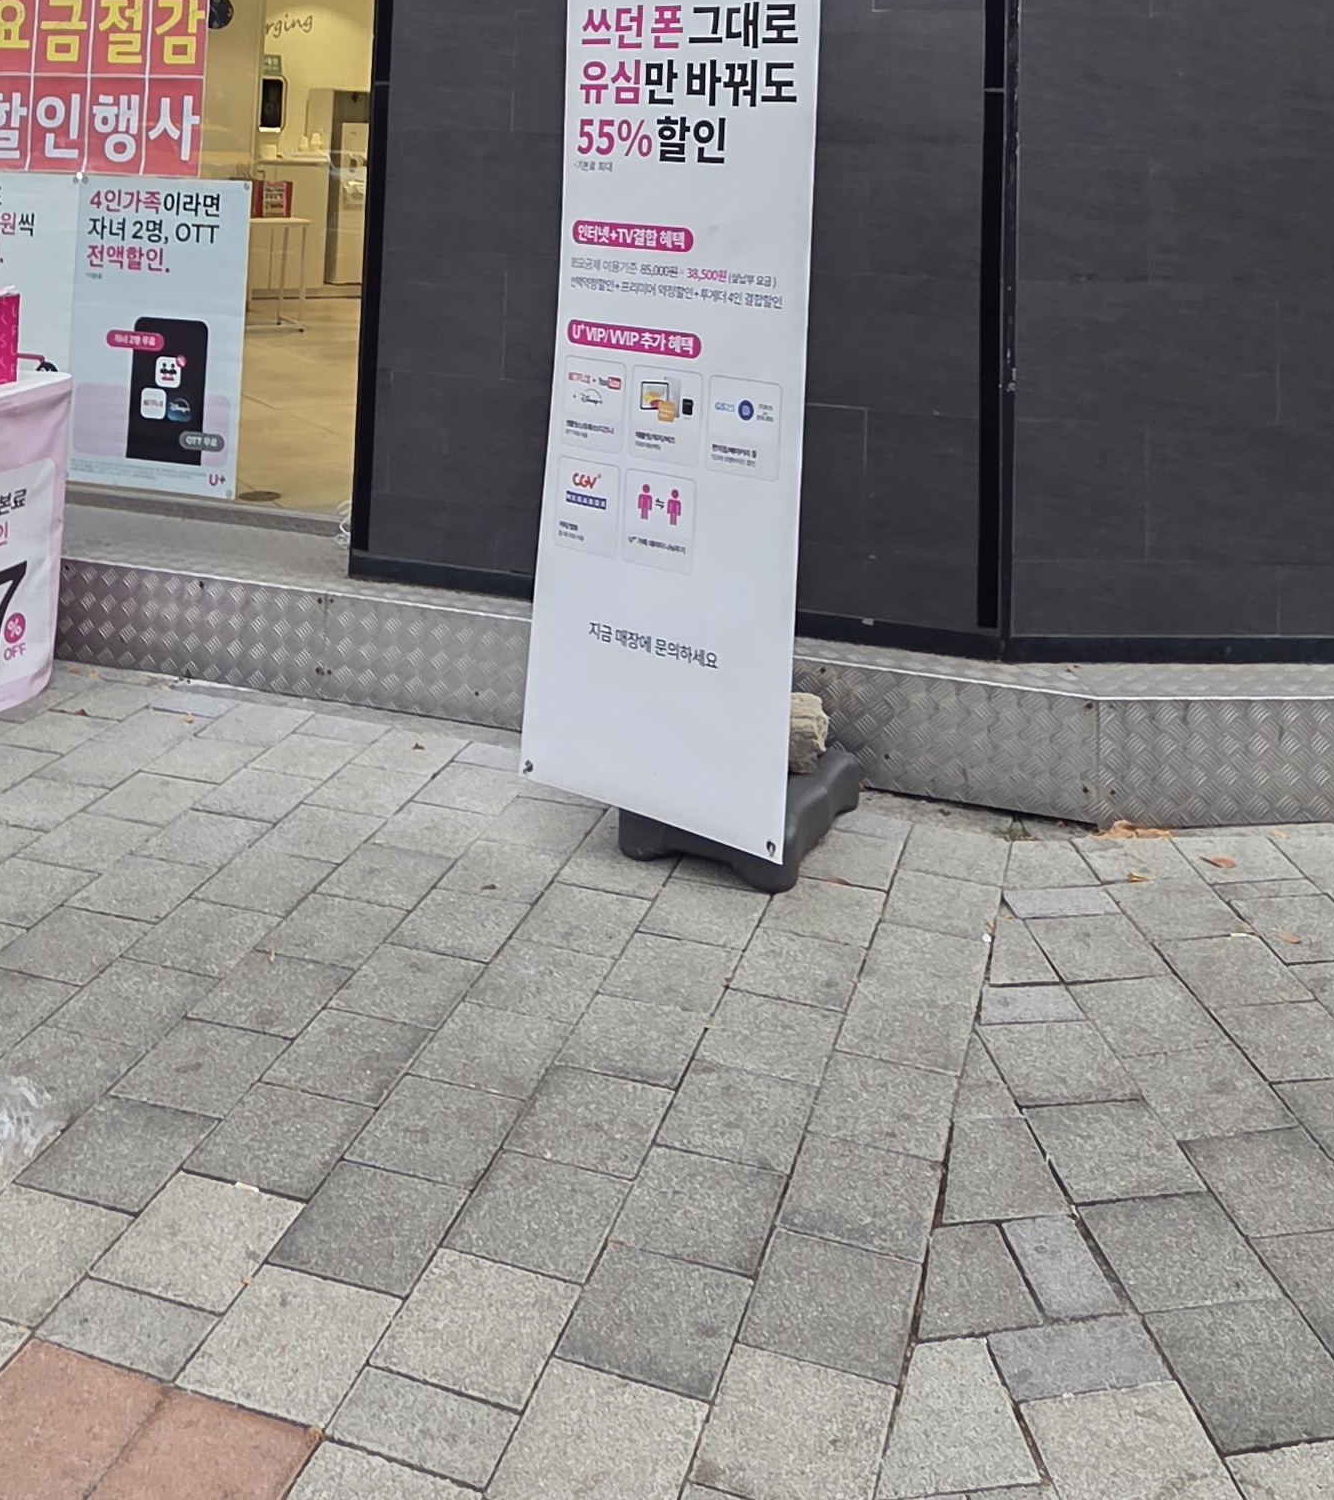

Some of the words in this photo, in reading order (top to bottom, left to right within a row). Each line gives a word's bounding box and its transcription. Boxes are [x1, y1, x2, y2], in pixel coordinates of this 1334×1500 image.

[581, 4, 644, 49] 쓰던
[650, 4, 684, 49] 폰
[688, 1, 799, 49] 그대로
[580, 59, 678, 105] 유심만
[686, 59, 797, 108] 바꿔도
[577, 117, 653, 158] 55%
[656, 115, 726, 165] 할인
[90, 189, 220, 218] 4인가족이라면
[87, 216, 126, 243] 자녀
[132, 220, 169, 245] 2명,
[175, 223, 220, 244] OTT
[659, 230, 685, 249] 혜택
[86, 244, 171, 273] 전액할인.
[640, 331, 666, 351] 추가
[668, 334, 694, 355] 혜택
[208, 473, 226, 487] U+
[572, 472, 598, 489] CGV
[4, 642, 26, 660] OFF
[588, 621, 612, 644] 지금
[615, 628, 652, 654] 매장에
[654, 638, 719, 670] 문의하세요
